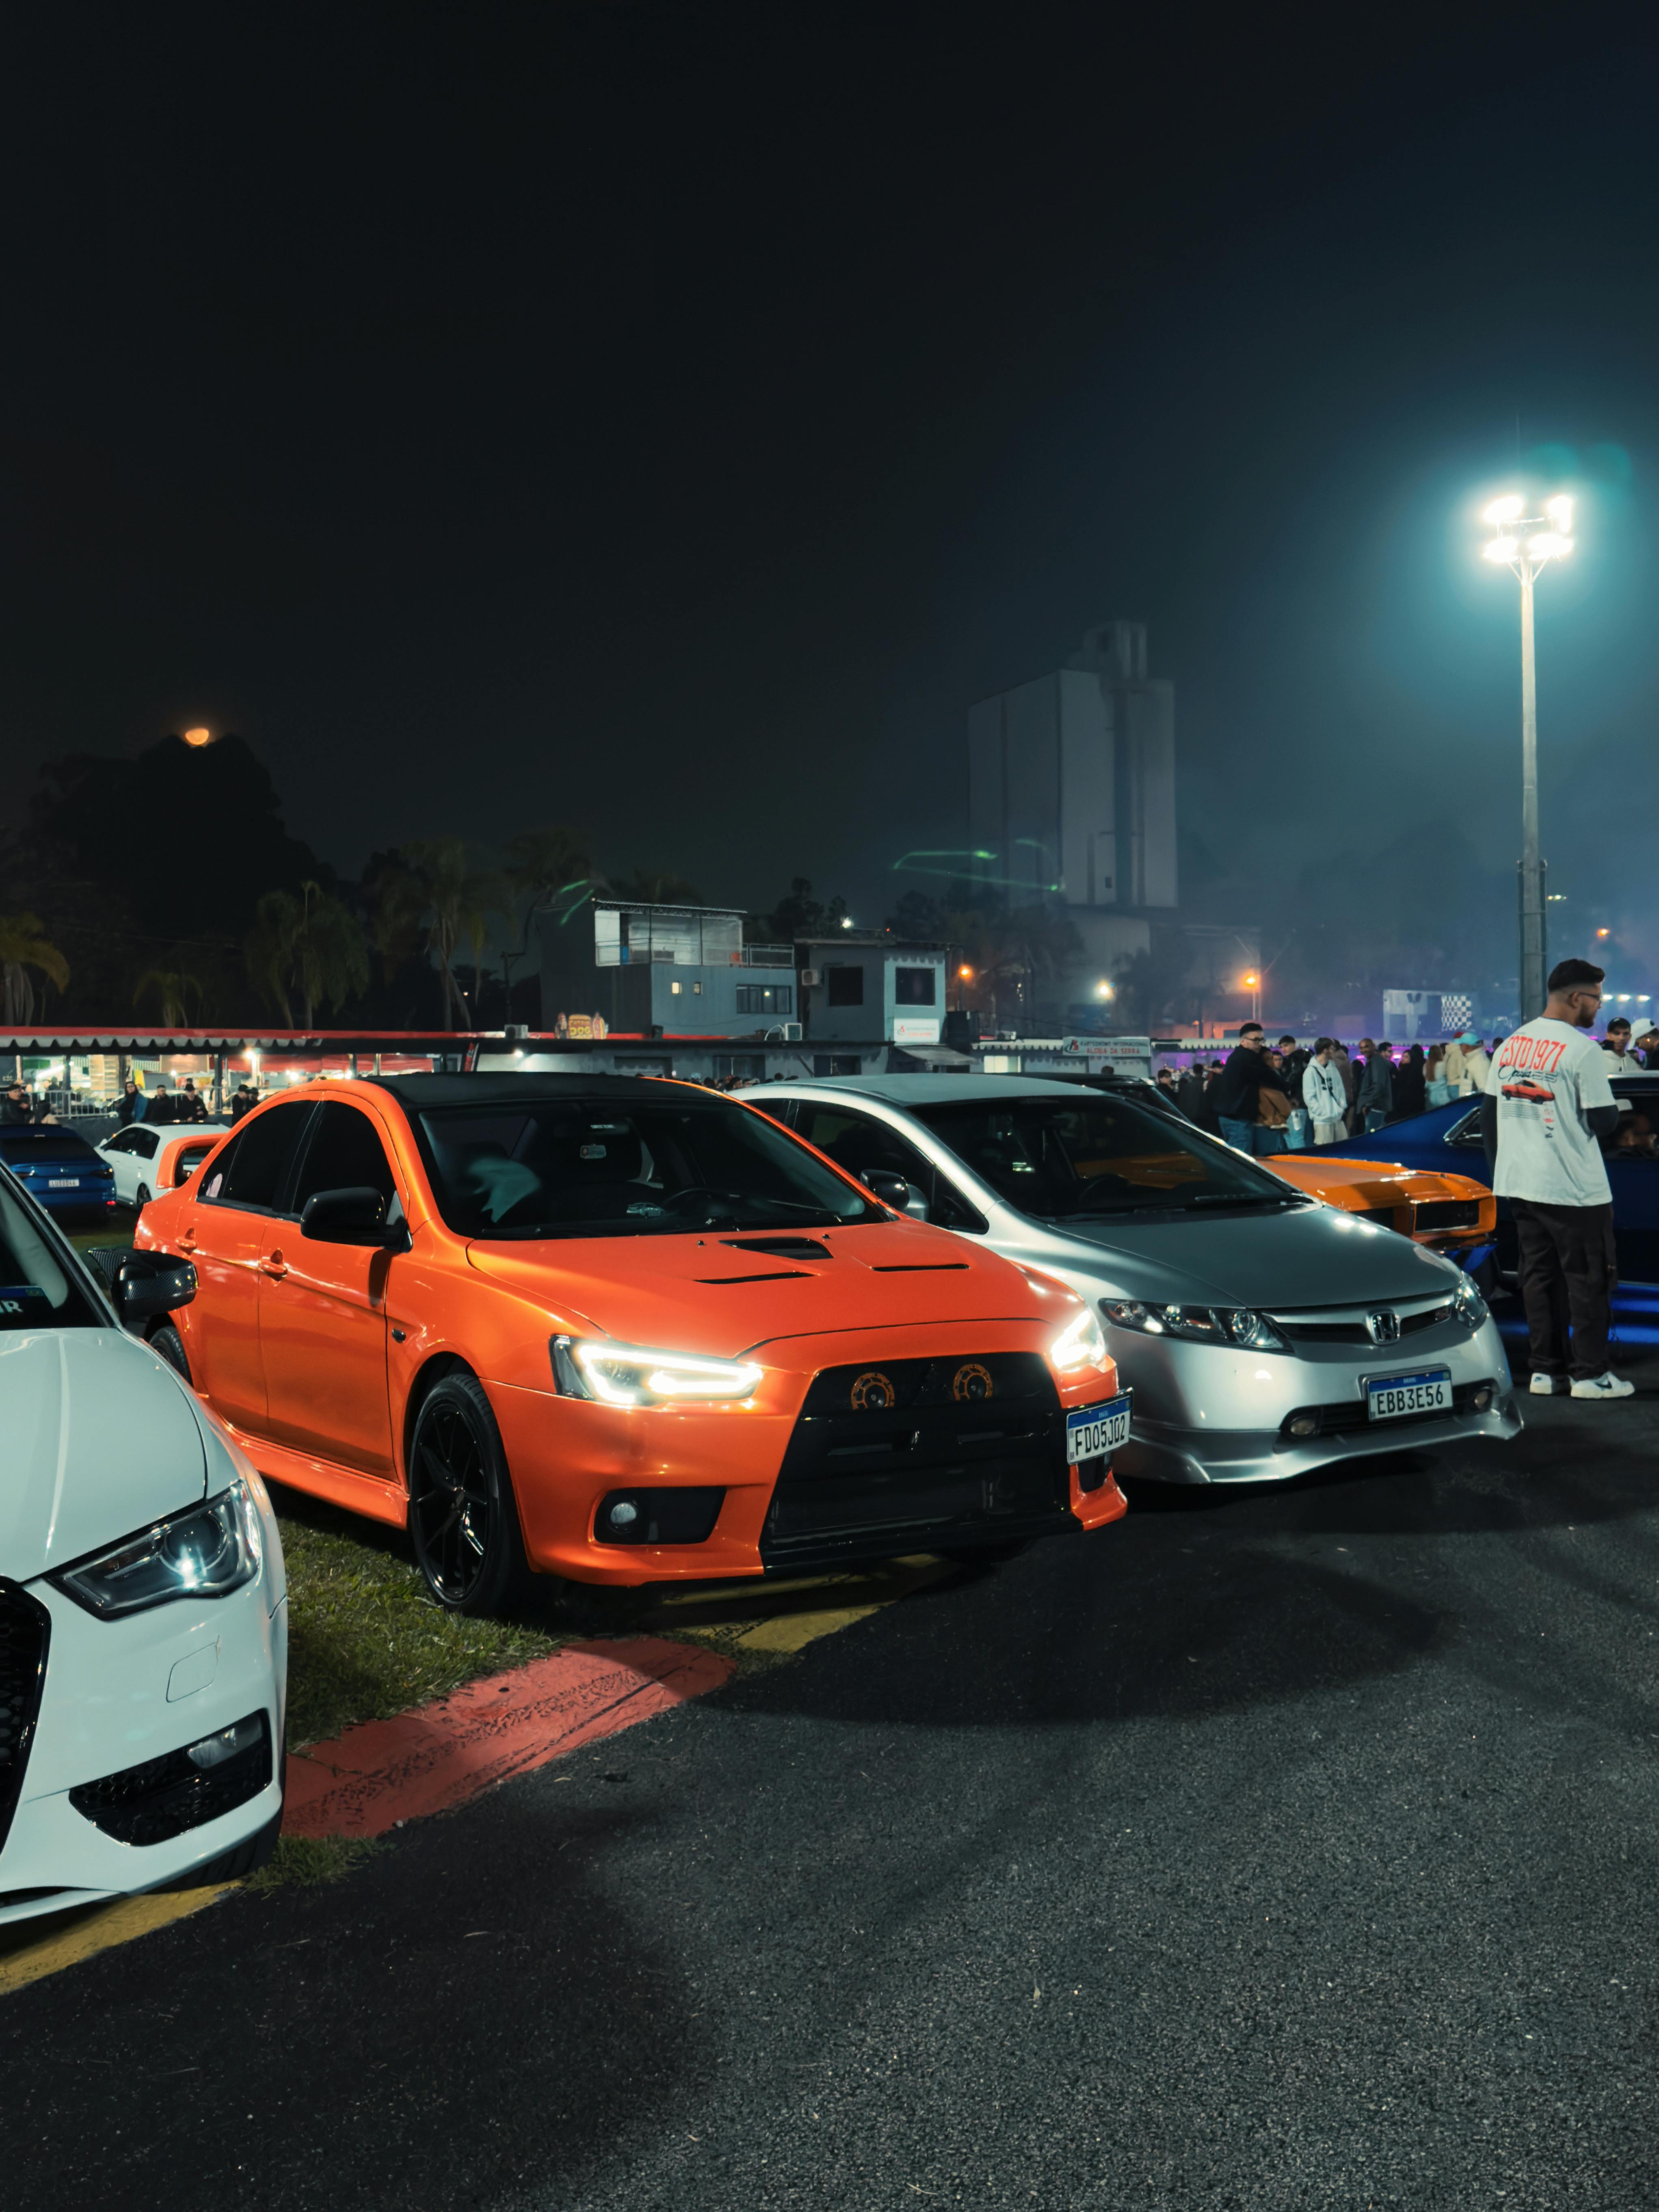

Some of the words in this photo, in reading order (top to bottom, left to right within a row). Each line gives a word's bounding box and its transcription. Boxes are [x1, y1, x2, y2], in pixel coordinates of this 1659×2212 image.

[570, 1026, 591, 1035] DOG
[1499, 1035, 1534, 1068] ESTD
[1529, 1039, 1567, 1073] 1971
[1377, 1384, 1443, 1415] EBB3E56
